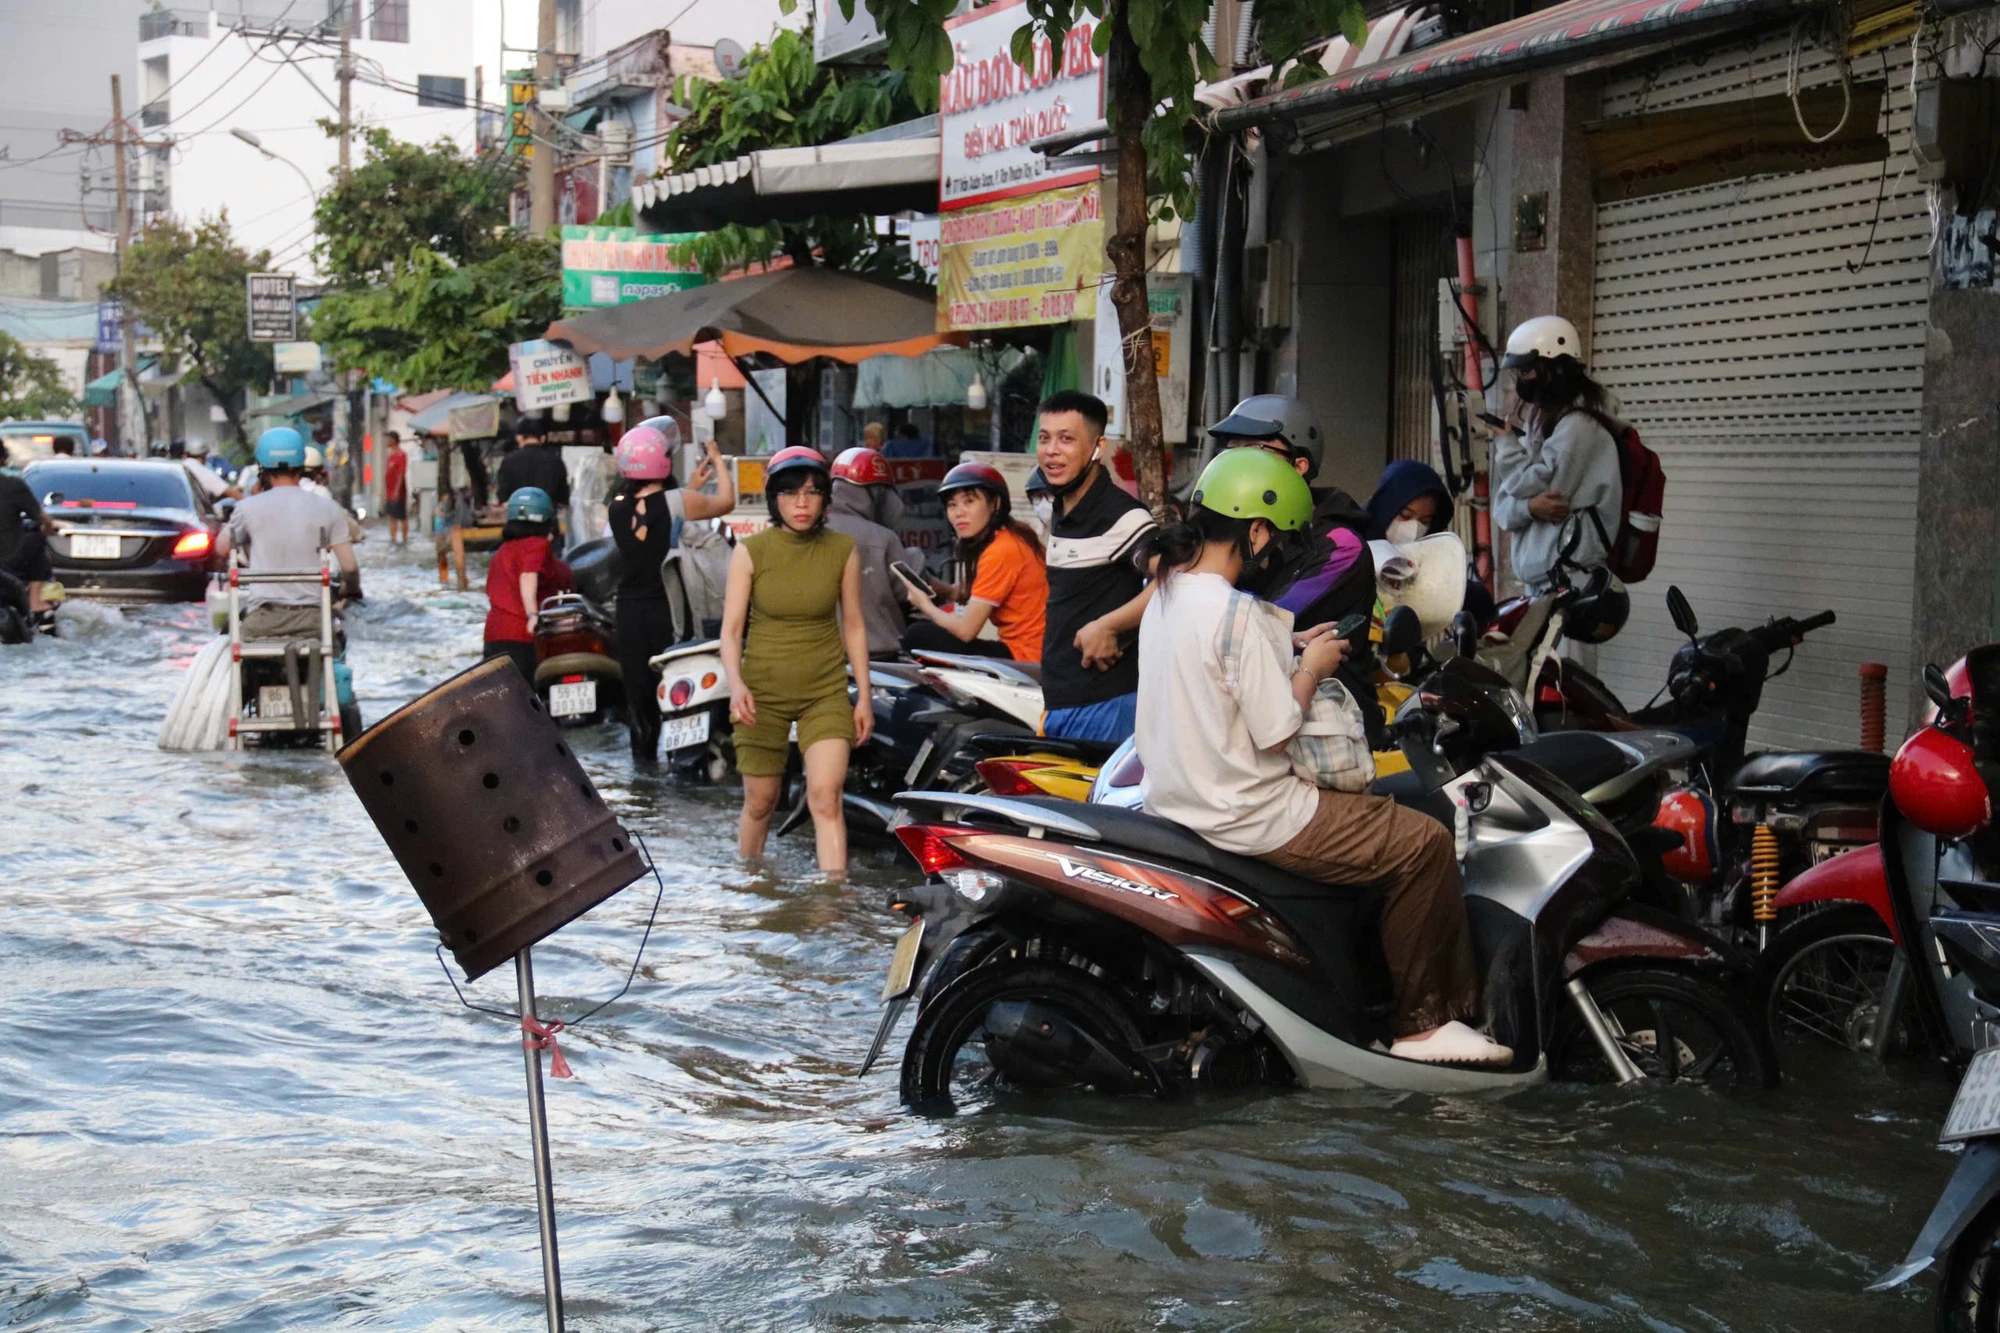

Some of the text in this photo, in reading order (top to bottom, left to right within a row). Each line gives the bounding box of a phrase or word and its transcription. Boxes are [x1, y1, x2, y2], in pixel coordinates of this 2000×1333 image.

[987, 123, 1005, 151] HOA
[252, 278, 291, 295] HOTEL
[624, 284, 665, 299] napas
[551, 367, 583, 382] NHANH
[541, 381, 572, 392] MOMO
